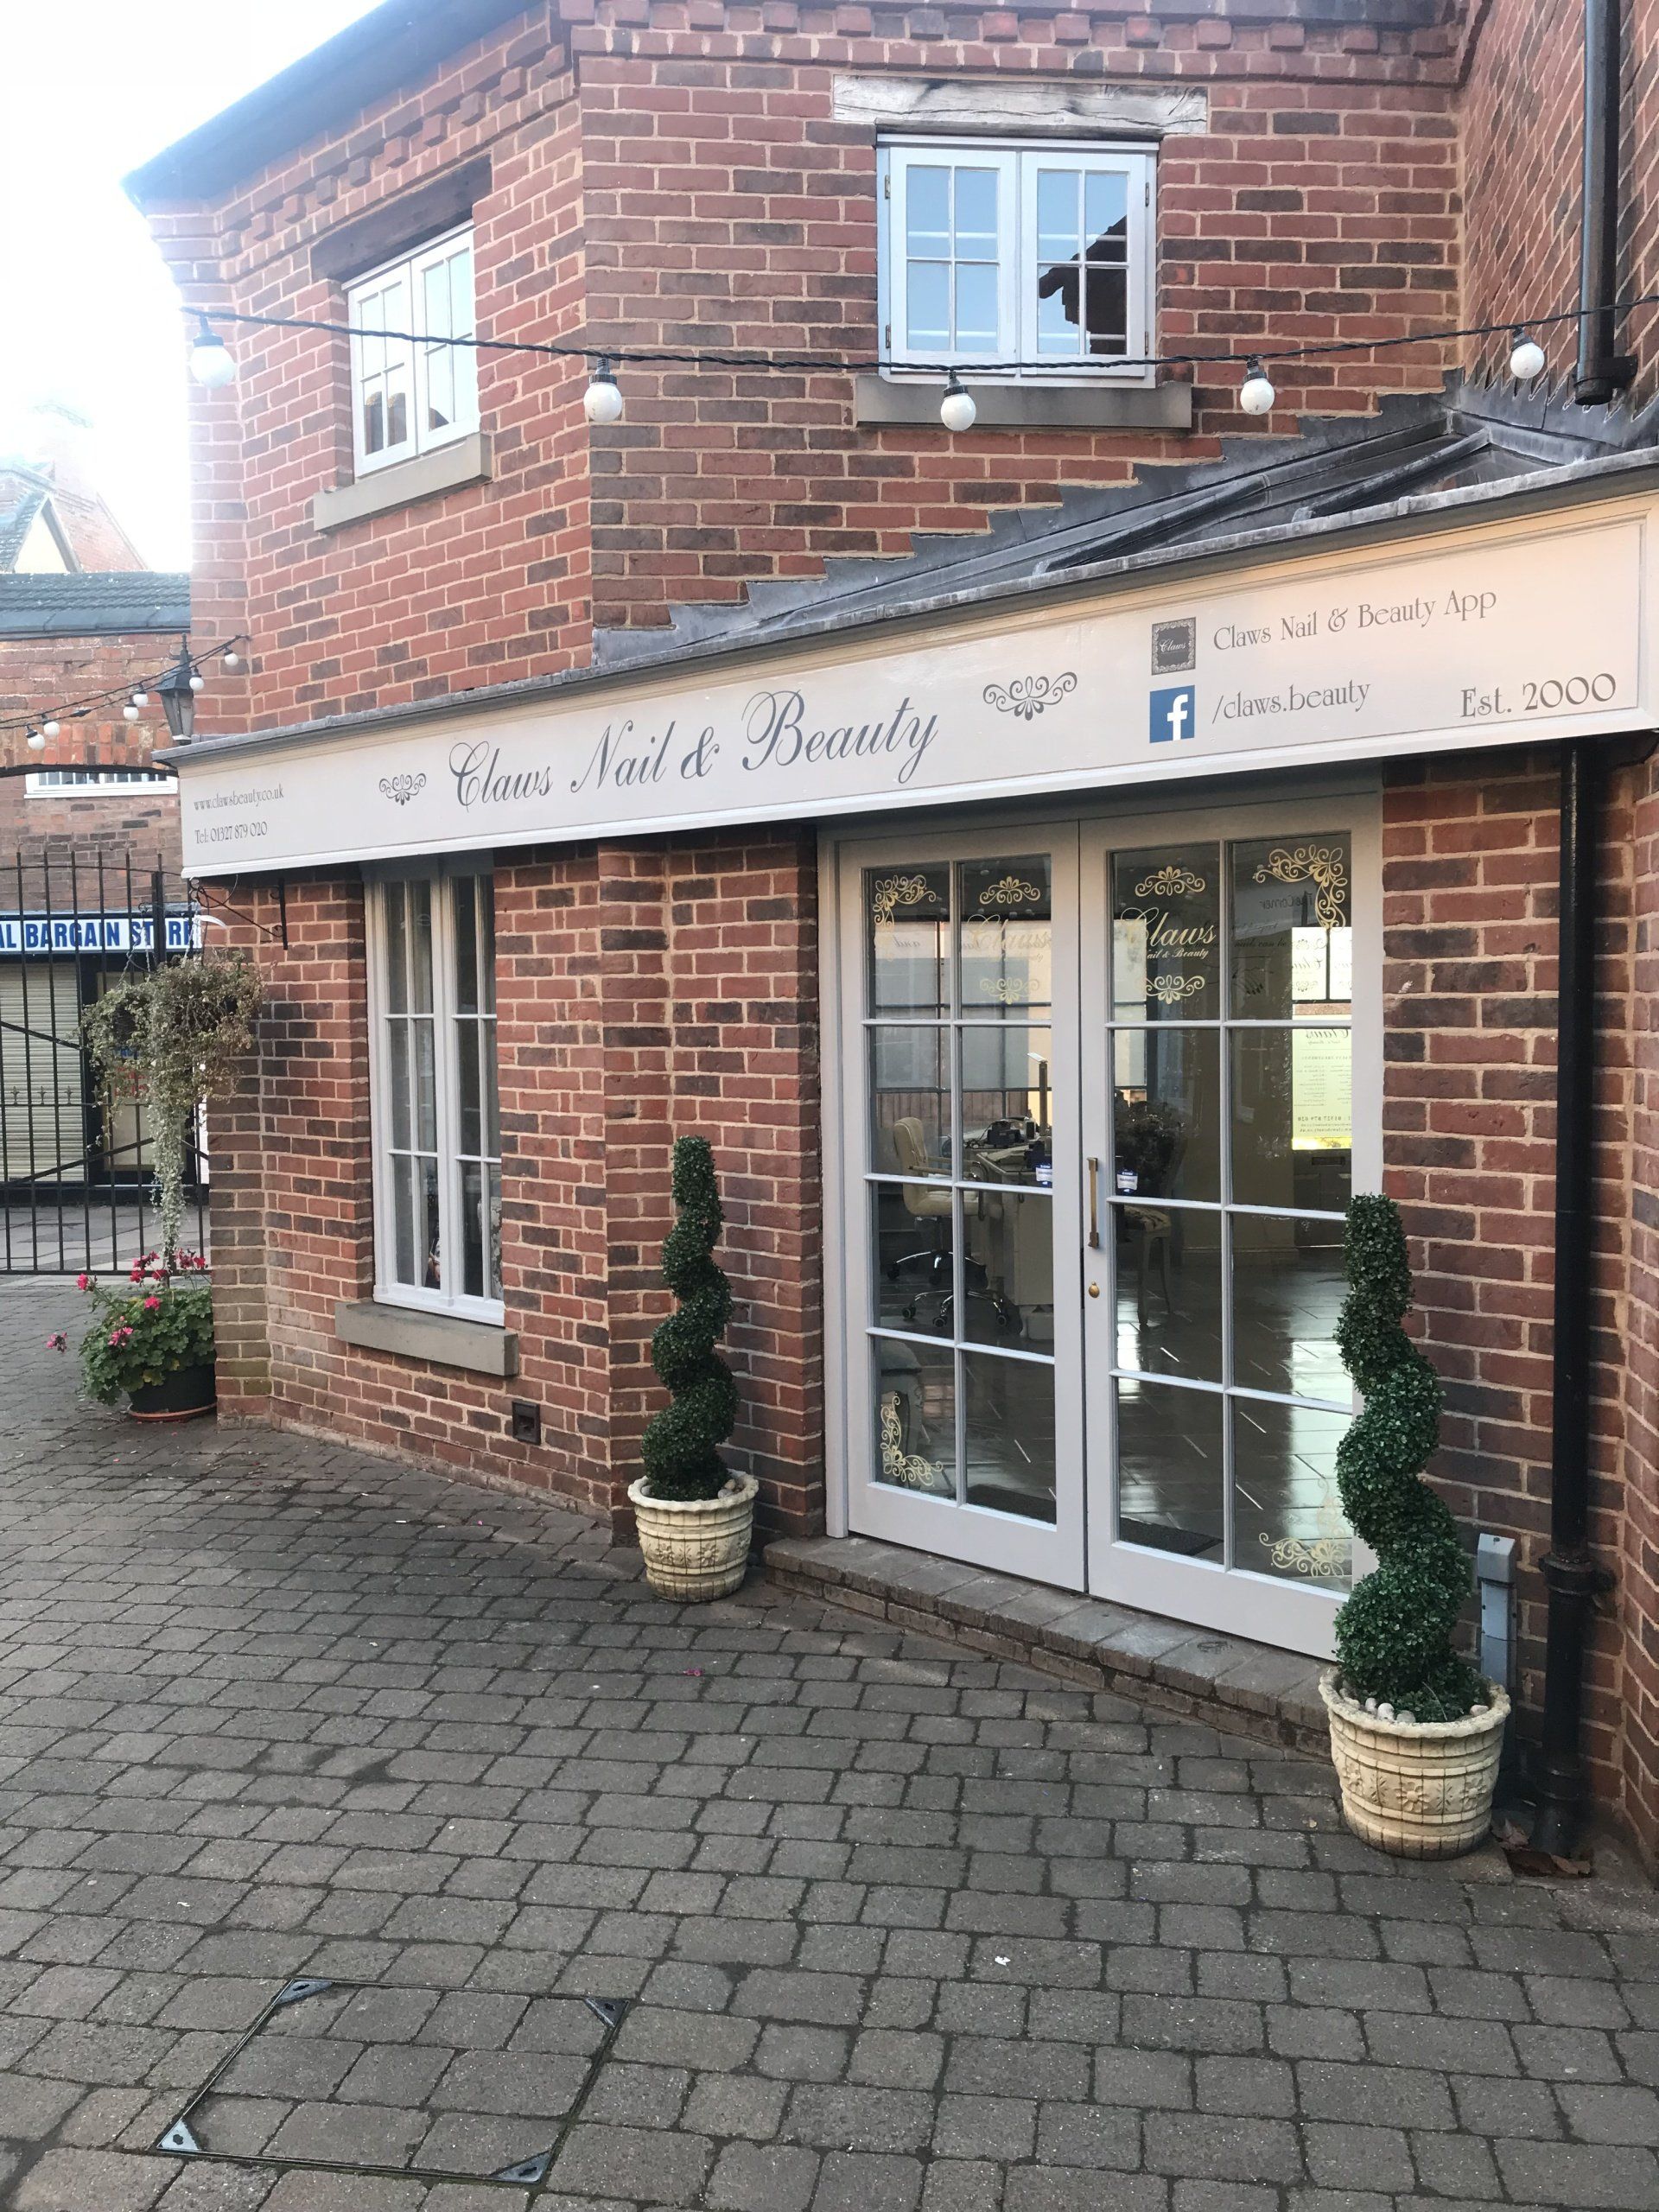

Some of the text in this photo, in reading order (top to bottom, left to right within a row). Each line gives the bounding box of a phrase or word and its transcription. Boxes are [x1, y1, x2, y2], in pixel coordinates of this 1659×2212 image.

[1213, 589, 1497, 650] Claws Nail & Beauty App
[1212, 679, 1371, 724] /claws.beauty
[1460, 673, 1616, 718] Est. 2000
[448, 689, 939, 812] Claws Nail & Beauty
[194, 784, 284, 810] www.clawsbeauty.co.uk
[194, 821, 268, 844] Tel: 01327 879 020
[1172, 947, 1209, 960] Beauty
